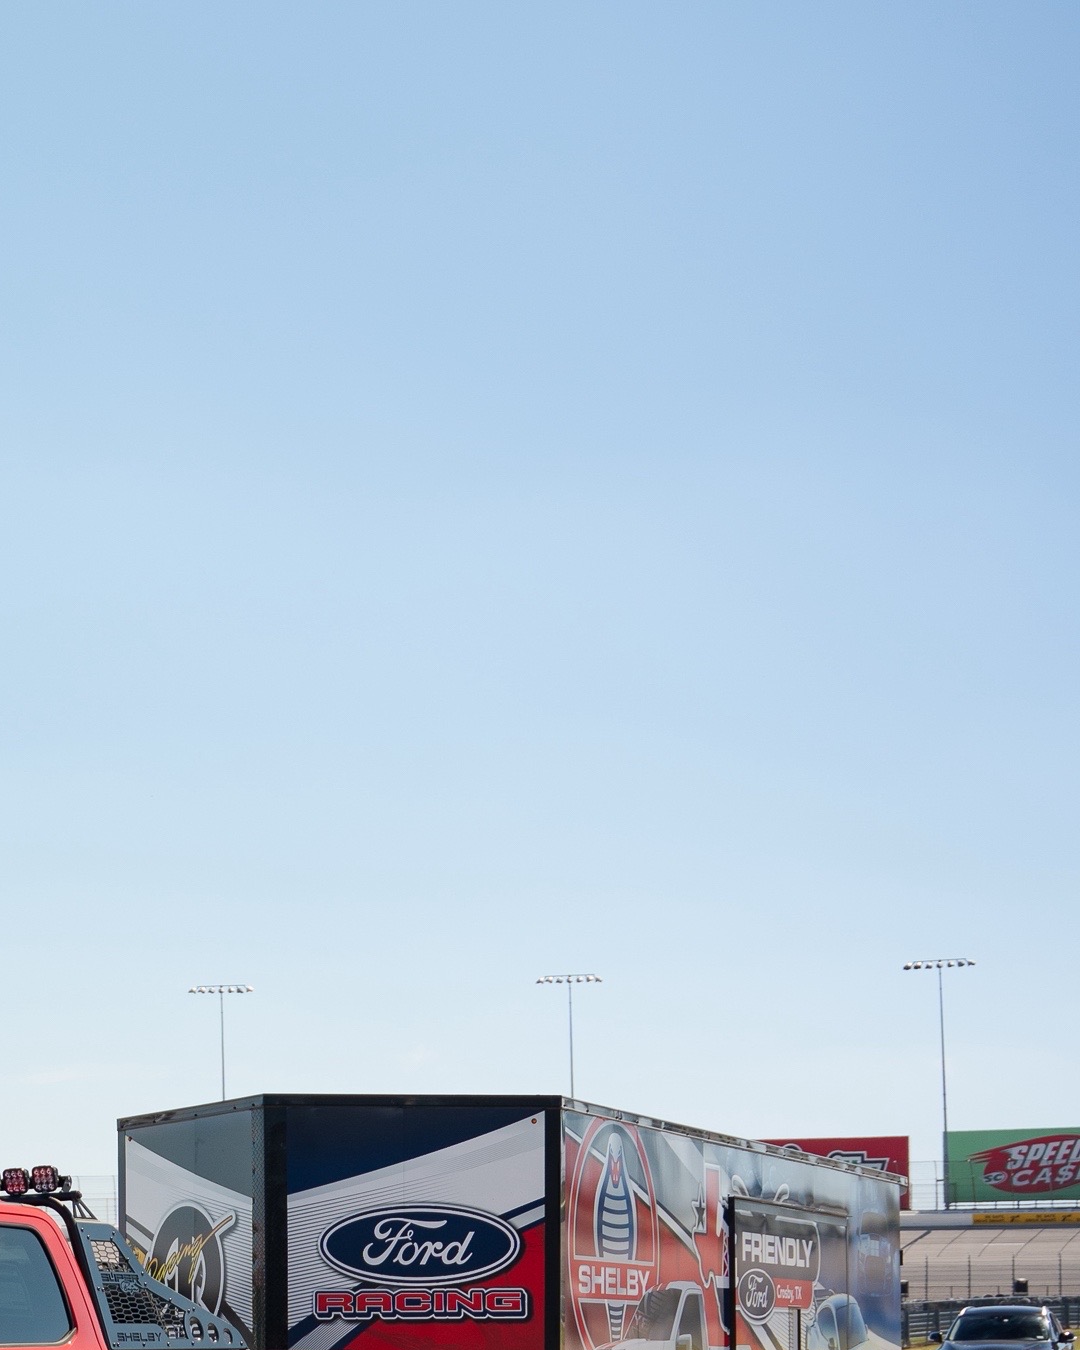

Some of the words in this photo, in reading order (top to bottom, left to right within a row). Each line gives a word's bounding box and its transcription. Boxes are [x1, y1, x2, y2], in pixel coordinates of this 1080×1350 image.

[362, 1217, 475, 1267] Ford
[742, 1231, 813, 1268] FRIENDLY
[101, 1272, 139, 1283] SUPER
[578, 1264, 650, 1296] SHELBY
[745, 1274, 769, 1308] Ford
[316, 1289, 526, 1317] RACING
[776, 1284, 794, 1303] Crosby,
[794, 1285, 802, 1300] TX
[117, 1332, 162, 1342] SHELBY
